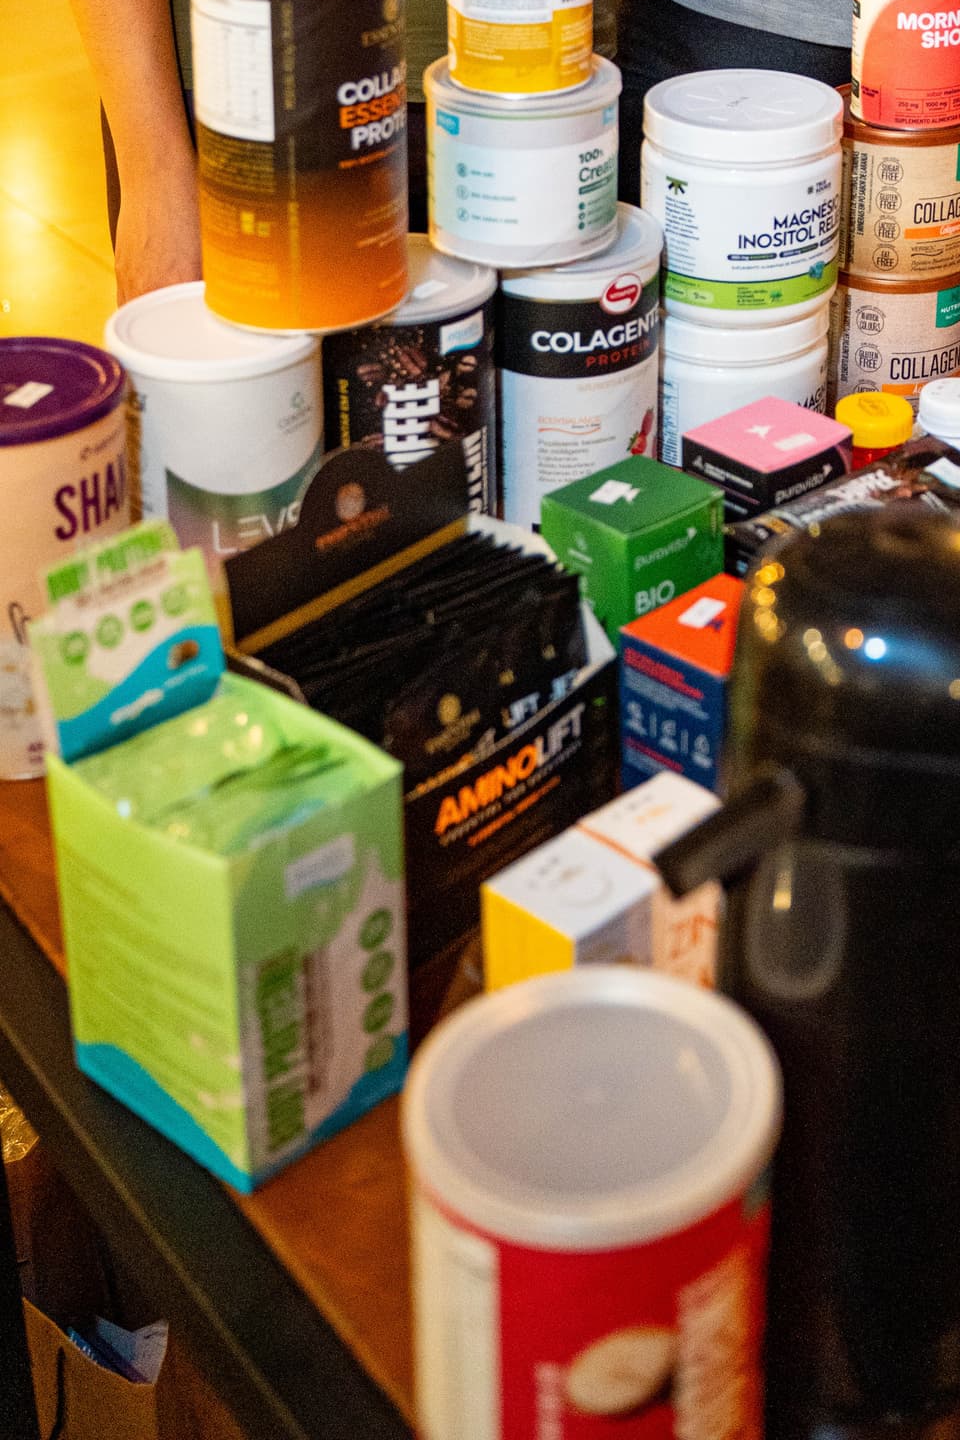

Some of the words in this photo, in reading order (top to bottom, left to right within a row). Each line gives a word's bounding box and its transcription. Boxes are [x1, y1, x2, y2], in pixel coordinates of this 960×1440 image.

[882, 164, 899, 172] SUGAR
[881, 172, 898, 181] FREE
[880, 200, 896, 210] FREE
[738, 225, 816, 250] INOSITOL
[878, 229, 895, 239] FREE
[876, 258, 894, 267] FREE
[860, 359, 877, 369] FREE
[890, 345, 960, 380] COLLAGEN
[635, 580, 676, 614] BIO
[434, 704, 586, 835] AMINOLIFT
